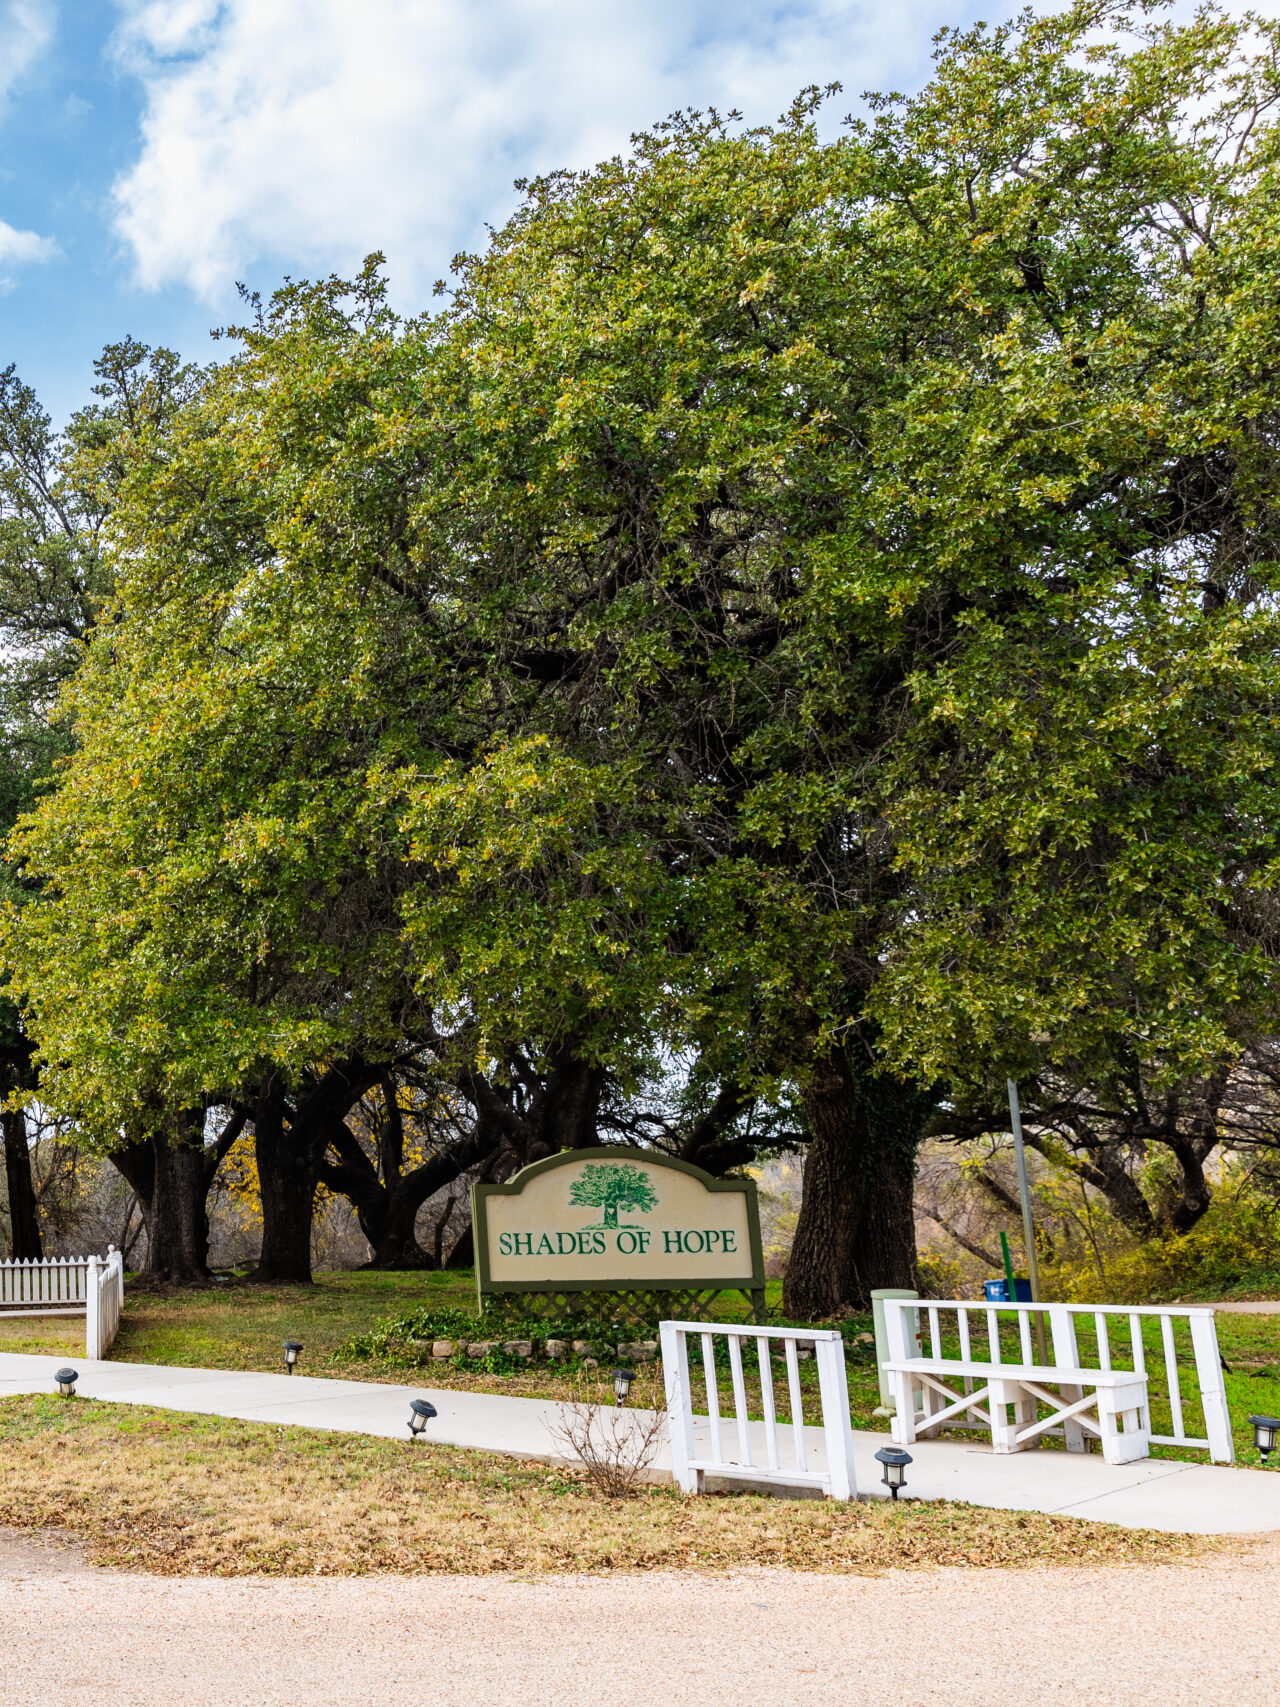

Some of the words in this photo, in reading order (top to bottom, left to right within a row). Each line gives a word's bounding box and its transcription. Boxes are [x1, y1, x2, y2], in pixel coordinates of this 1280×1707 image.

[499, 1231, 606, 1255] SHADES
[616, 1231, 651, 1254] OF
[662, 1230, 738, 1253] HOPE
